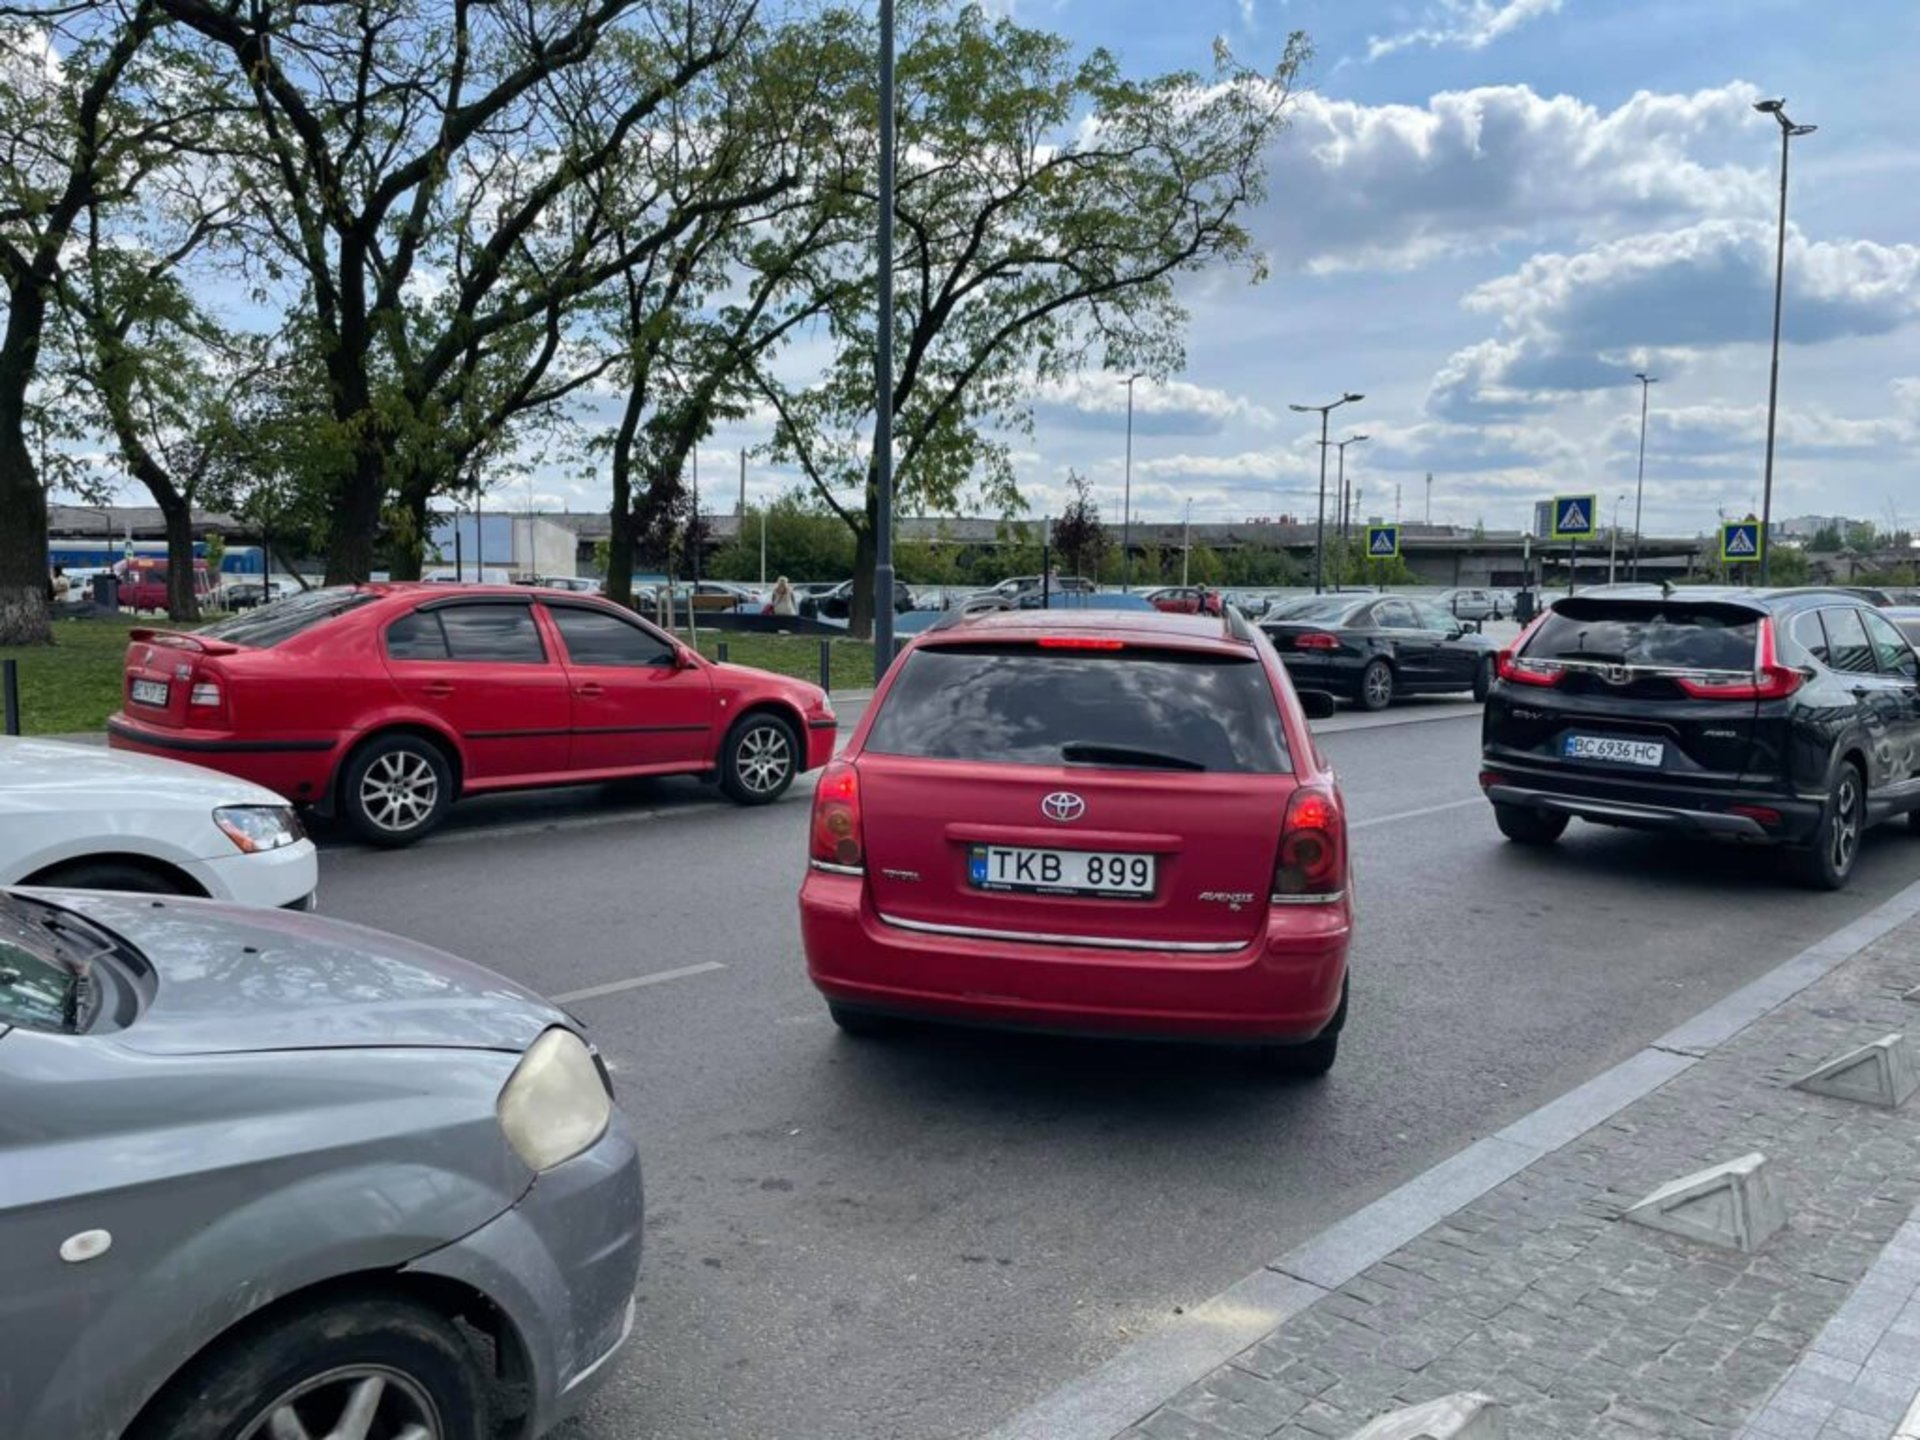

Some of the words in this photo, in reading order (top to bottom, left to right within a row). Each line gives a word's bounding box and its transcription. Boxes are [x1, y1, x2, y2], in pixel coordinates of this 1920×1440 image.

[1574, 738, 1595, 753] BC
[1597, 740, 1631, 757] 6936
[1634, 744, 1657, 760] HC
[972, 867, 986, 879] LT
[993, 850, 1062, 882] TKB
[1087, 856, 1148, 887] 899
